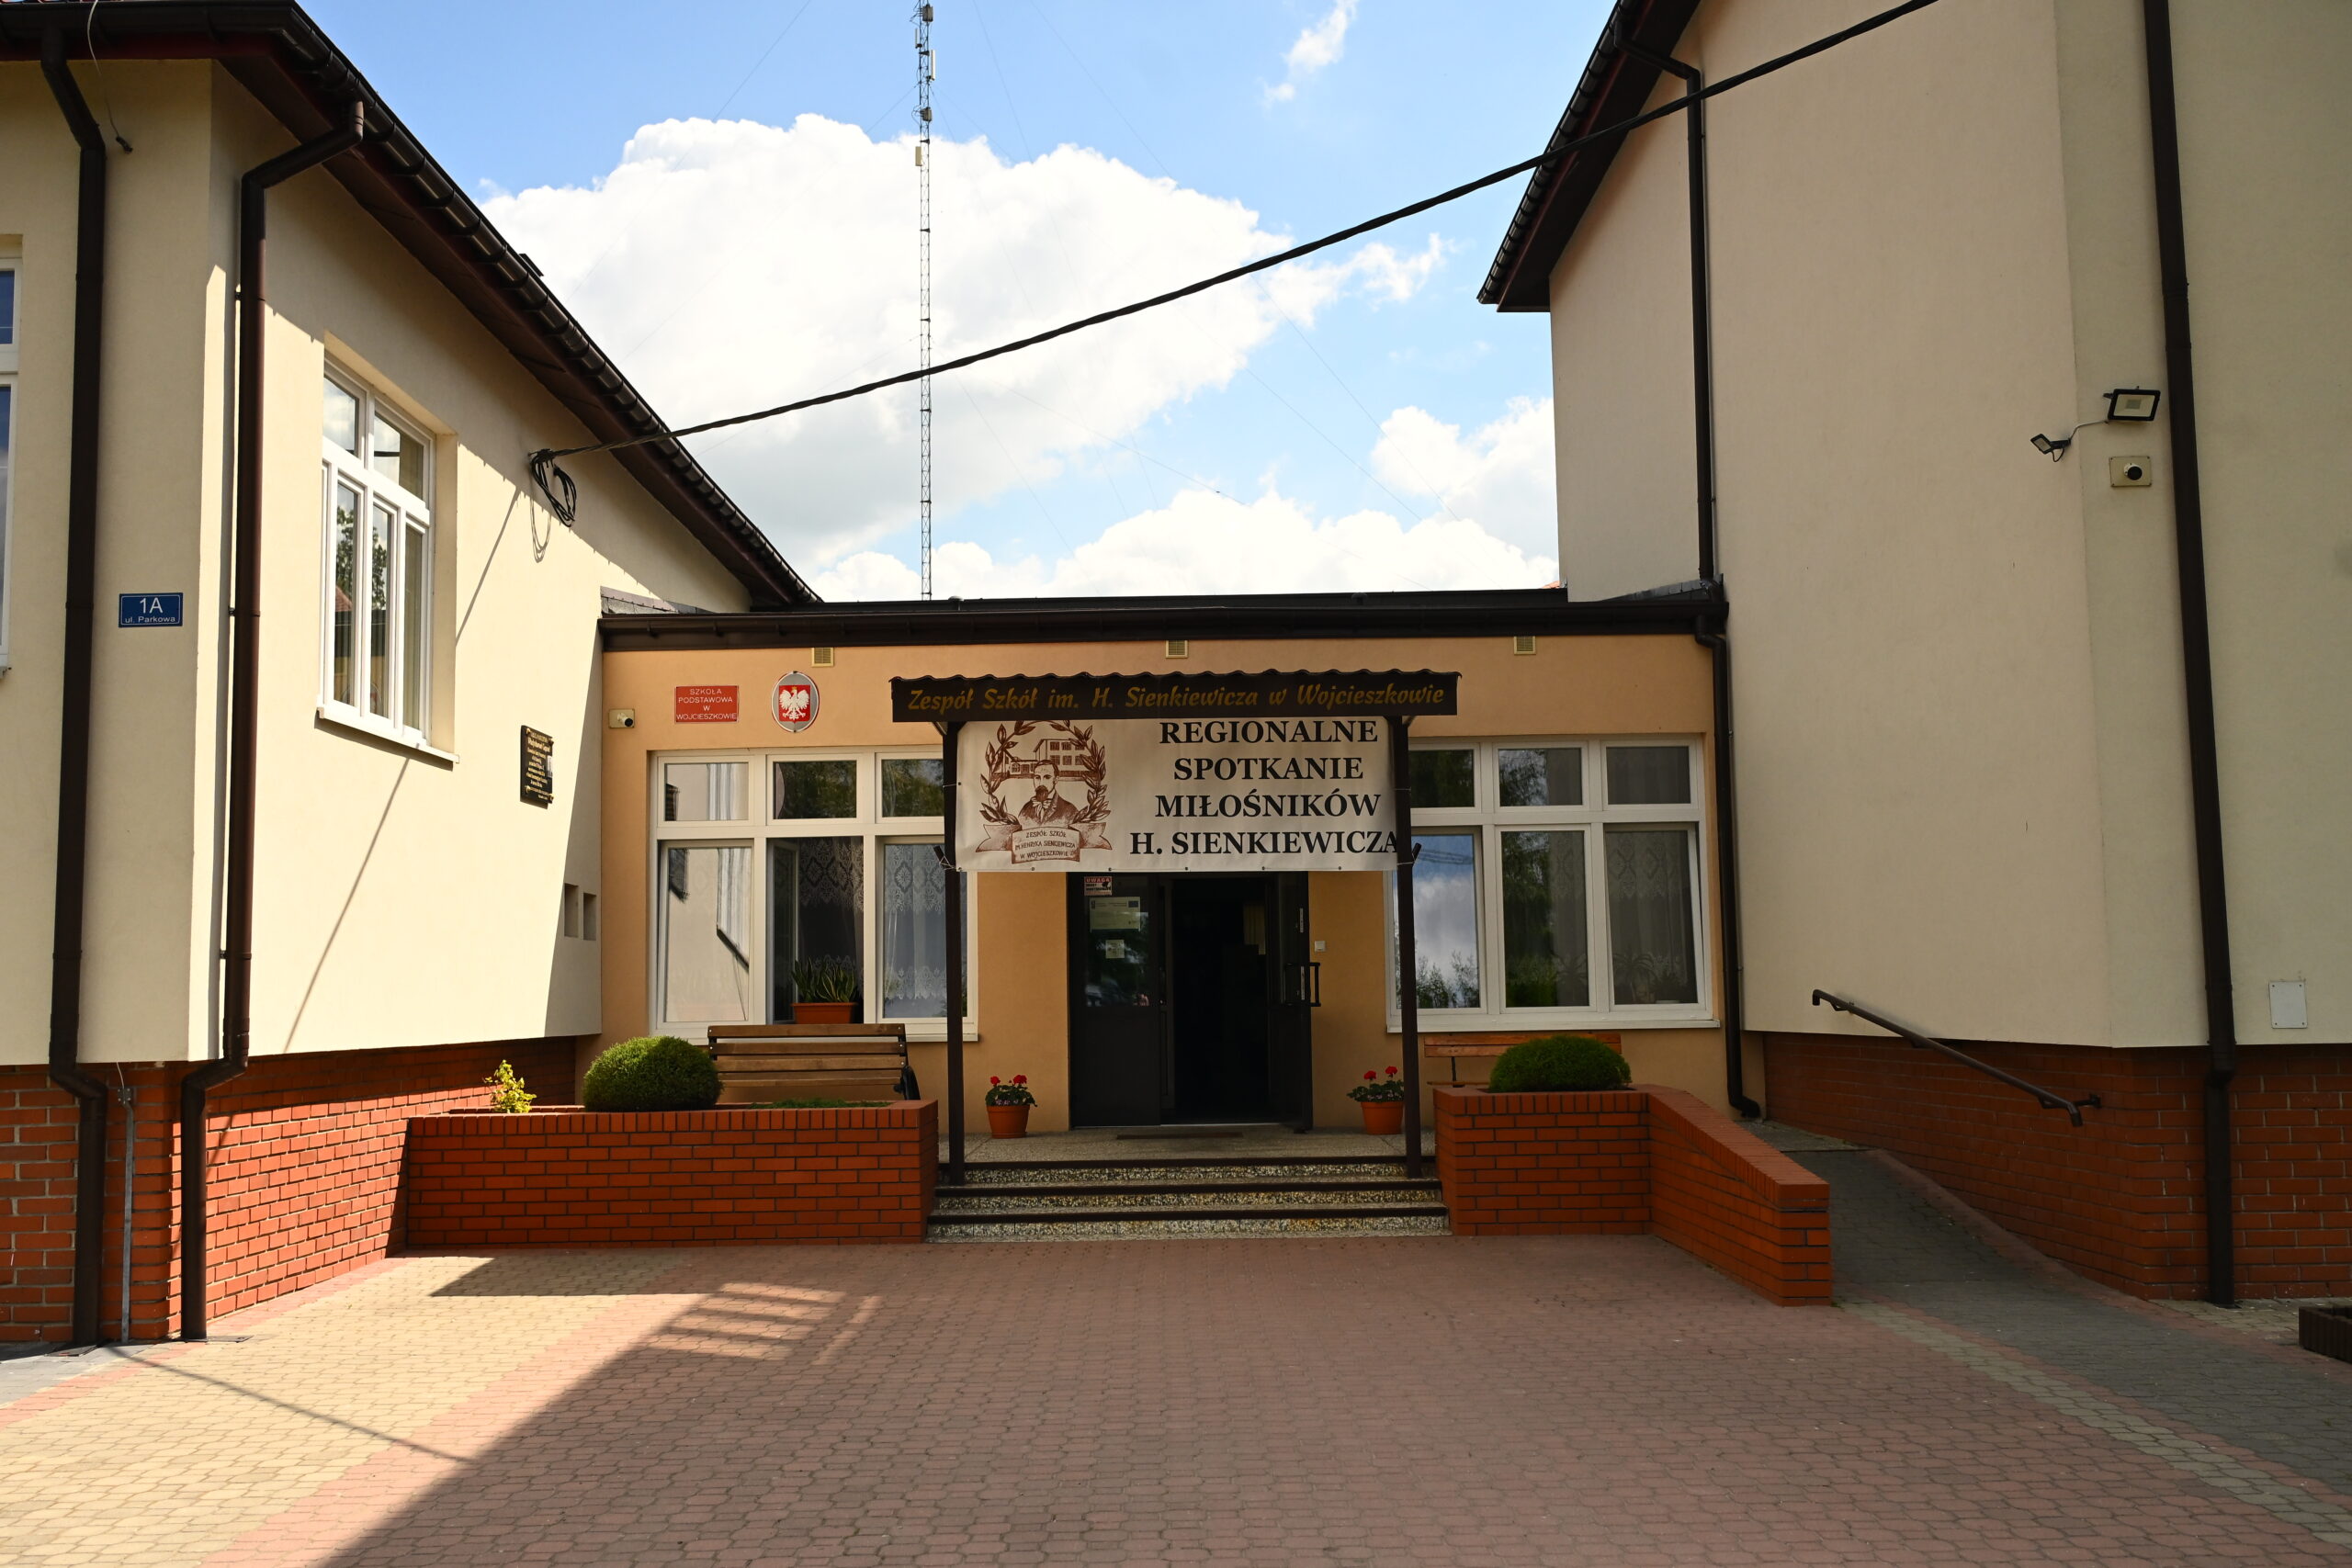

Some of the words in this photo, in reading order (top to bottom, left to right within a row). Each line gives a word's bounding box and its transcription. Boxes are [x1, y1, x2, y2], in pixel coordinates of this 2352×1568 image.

[140, 597, 164, 614] 1A
[908, 689, 974, 715] Zespół
[982, 688, 1038, 710] Szkół
[1047, 689, 1080, 708] im.
[1091, 687, 1114, 707] H.
[1125, 686, 1259, 707] Sienkiewicza
[1269, 689, 1286, 705] w
[1296, 684, 1444, 710] Wojcieszkowie
[1159, 720, 1378, 744] REGIONALNE
[1174, 757, 1363, 780] SPOTKANIE
[1154, 788, 1381, 818] MIŁOŚNIKÓW
[1129, 832, 1163, 855] H.
[1171, 830, 1397, 854] SIENKIEWICZA
